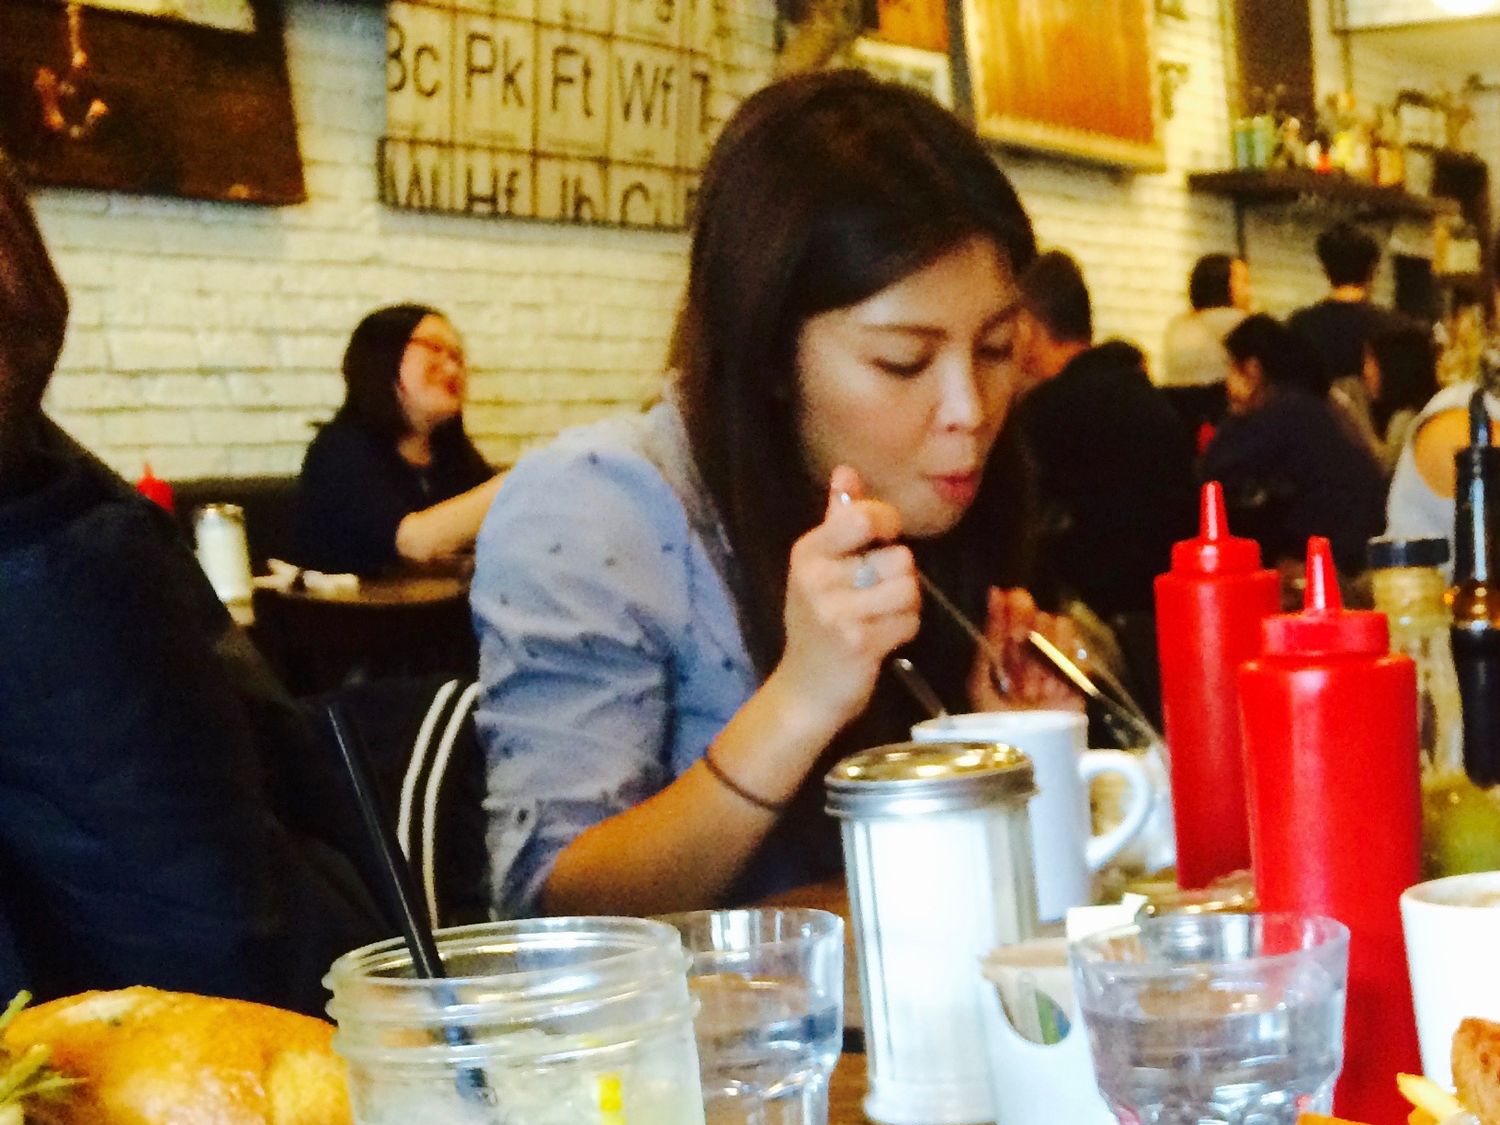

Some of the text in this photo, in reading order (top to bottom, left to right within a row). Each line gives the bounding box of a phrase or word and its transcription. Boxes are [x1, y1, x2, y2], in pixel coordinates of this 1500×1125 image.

[387, 18, 441, 97] Bc
[466, 32, 525, 107] Pk
[552, 46, 593, 118] Ft
[617, 58, 674, 130] Wf
